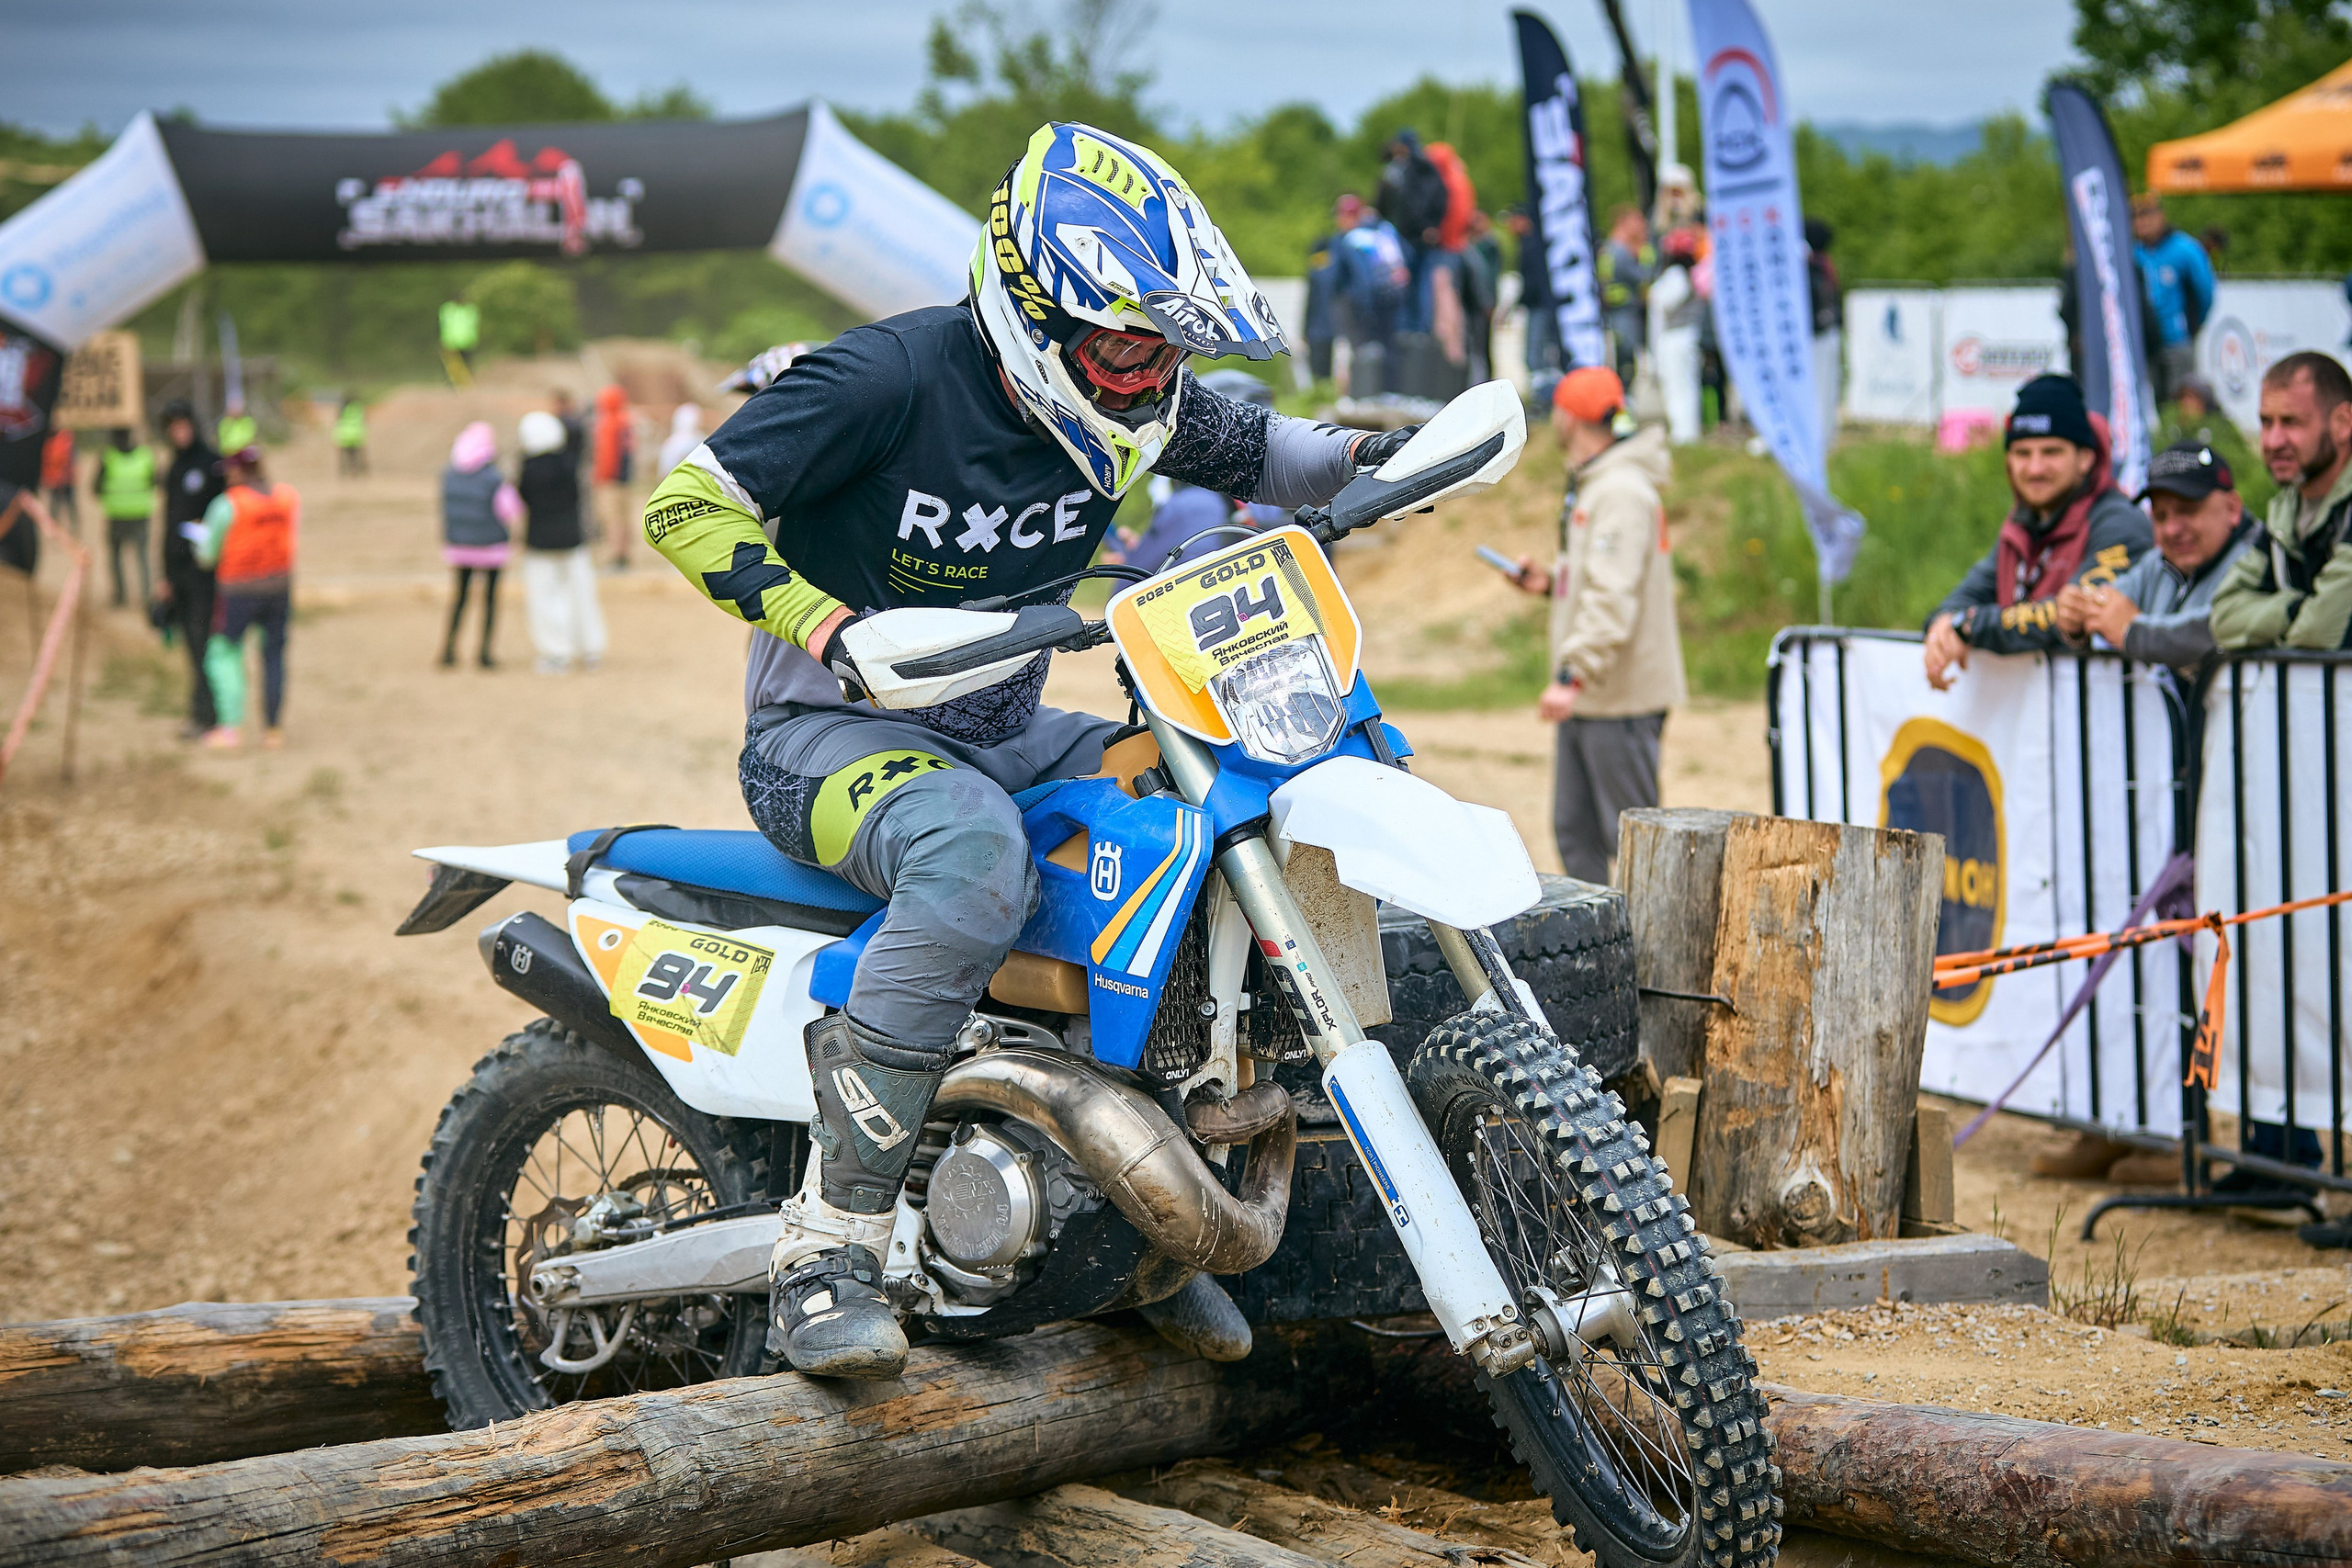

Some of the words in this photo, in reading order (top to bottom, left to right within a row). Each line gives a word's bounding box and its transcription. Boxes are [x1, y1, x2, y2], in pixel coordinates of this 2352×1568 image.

[990, 179, 1057, 321] 100%
[1103, 463, 1112, 489] AIROH
[891, 547, 940, 575] LET'S
[944, 564, 989, 580] RACE
[1199, 552, 1266, 590] GOLD
[1189, 575, 1285, 652] 94
[1212, 620, 1289, 660] Янковский
[1218, 632, 1290, 667] Вячеслав
[689, 937, 750, 964] GOLD
[637, 953, 739, 1014] 94
[1094, 972, 1149, 999] Husqvarna
[1310, 987, 1338, 1032] XPLOR
[1364, 1145, 1374, 1159] FOR
[1373, 1161, 1391, 1190] PIONEERS
